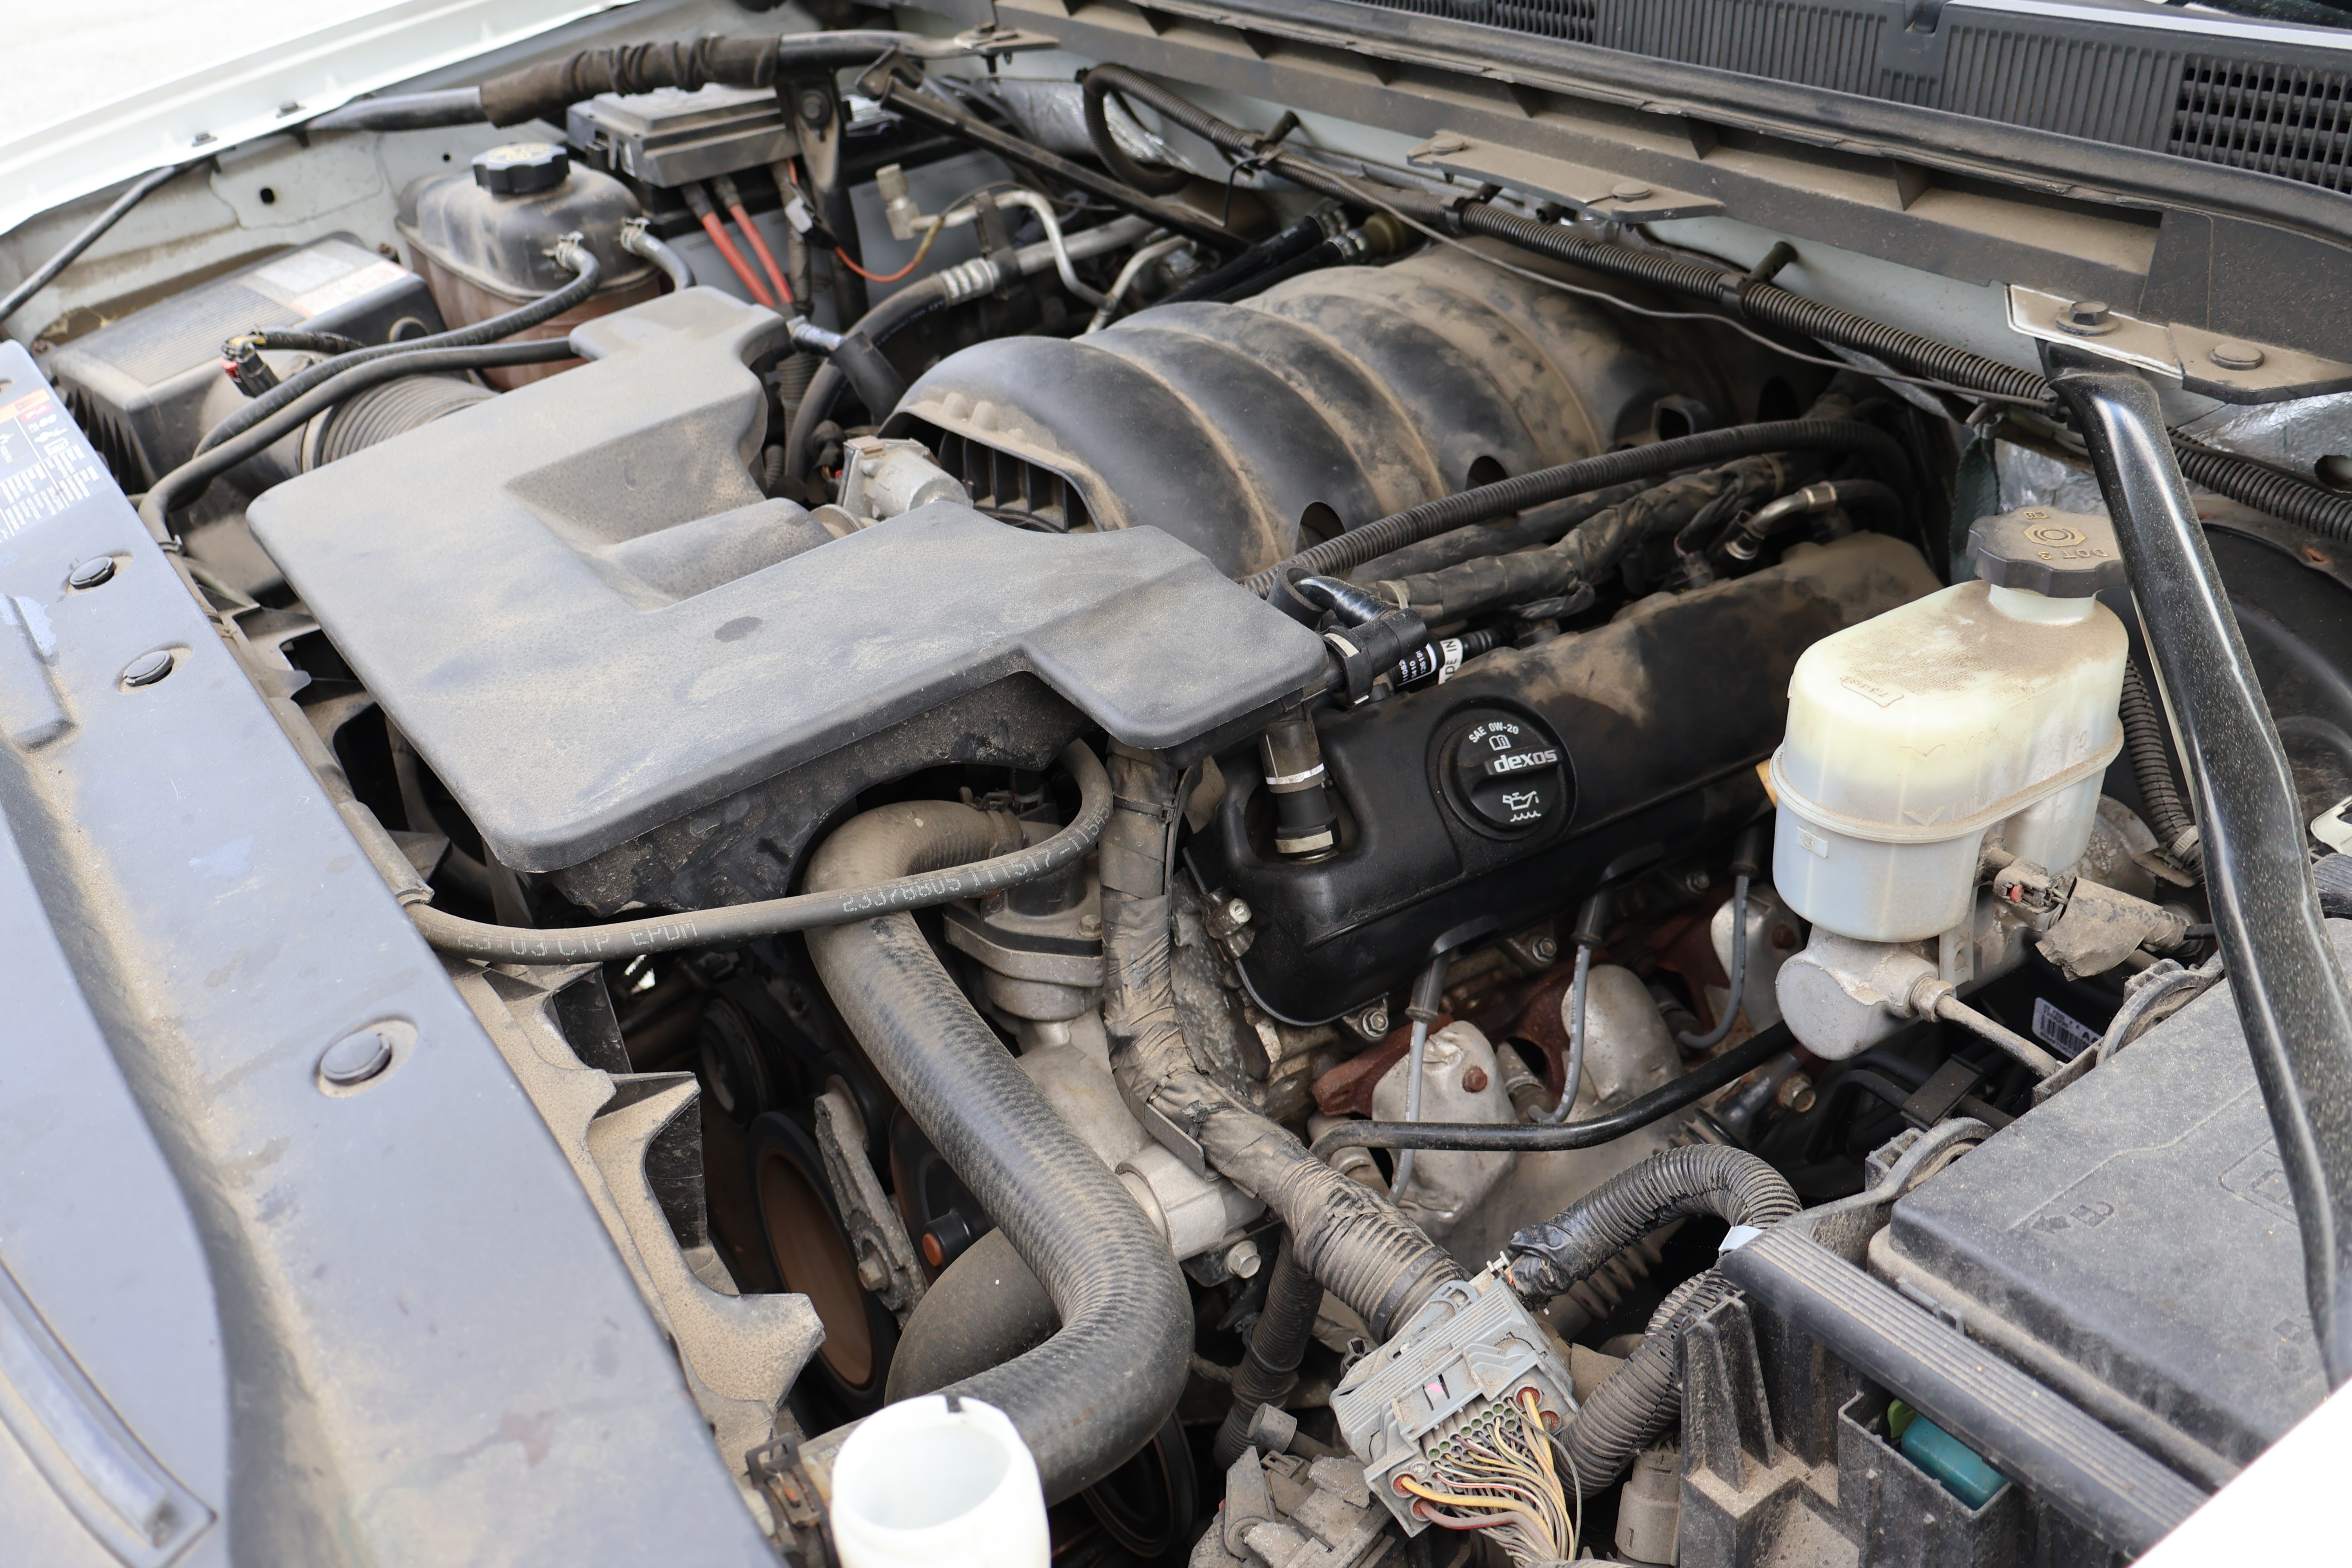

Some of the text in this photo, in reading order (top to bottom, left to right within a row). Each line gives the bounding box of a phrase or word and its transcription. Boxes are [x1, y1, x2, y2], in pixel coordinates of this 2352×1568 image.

[2038, 548, 2109, 560] DOT 3
[1446, 640, 1458, 652] IN
[1468, 722, 1519, 743] SAE 0W-20
[1494, 749, 1558, 773] dexos
